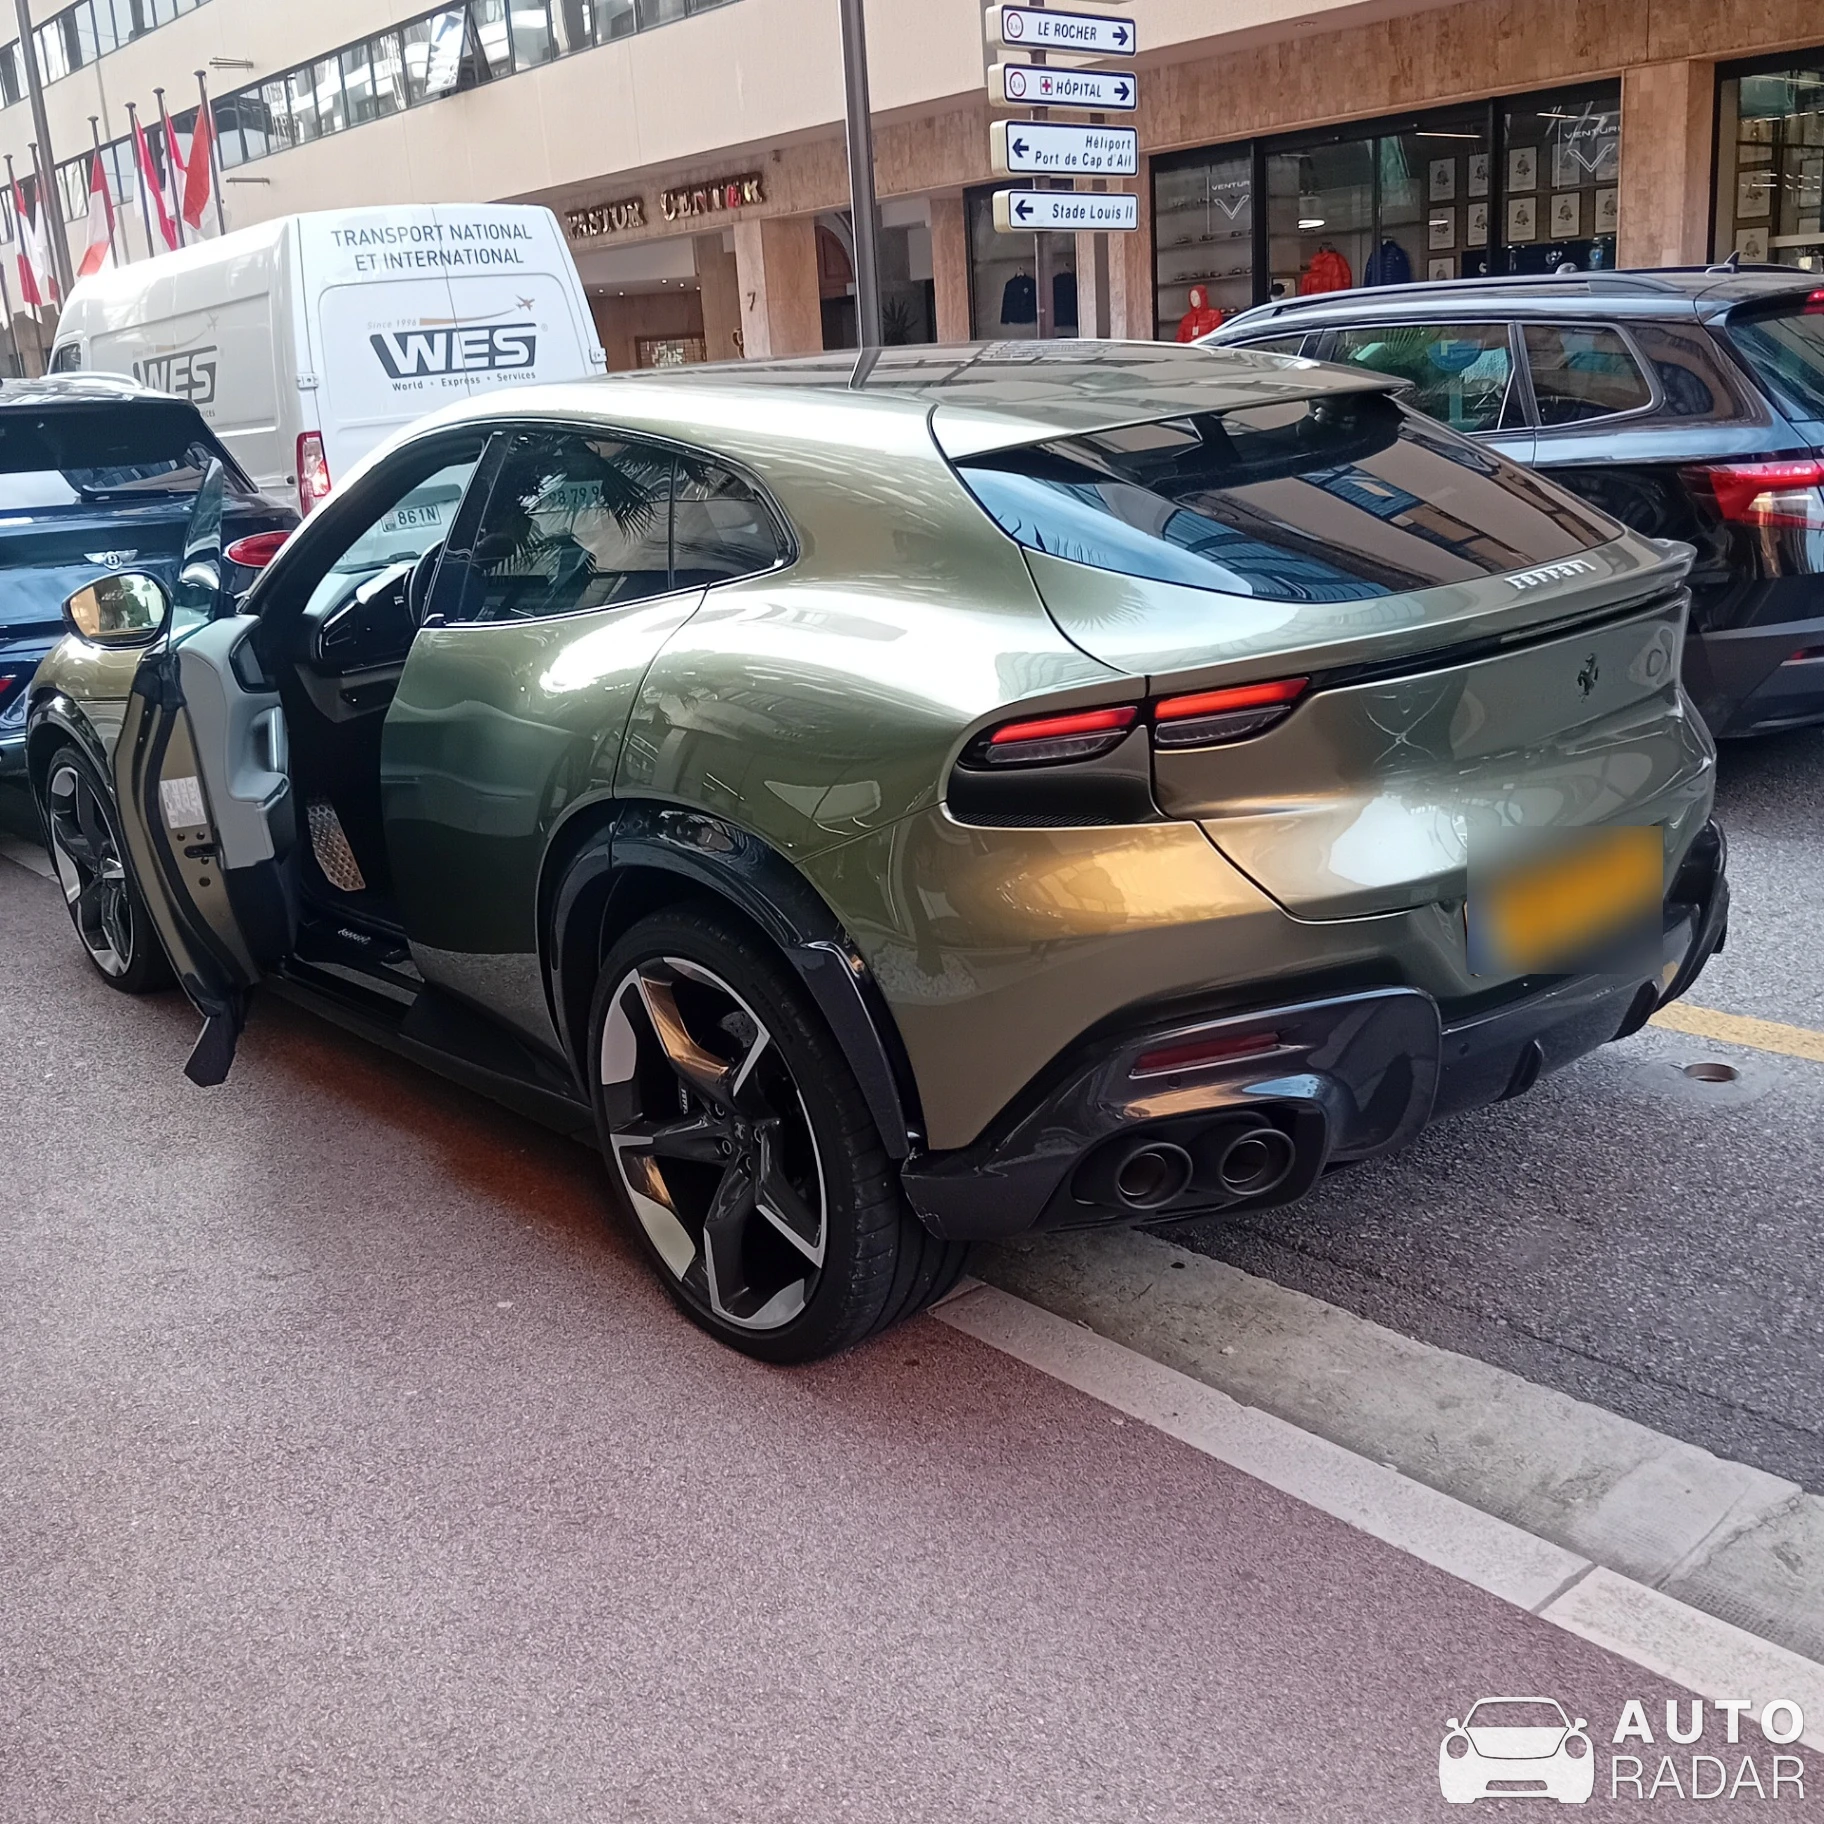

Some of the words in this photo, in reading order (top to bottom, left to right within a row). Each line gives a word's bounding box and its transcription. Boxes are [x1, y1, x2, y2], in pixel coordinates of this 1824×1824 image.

[1038, 21, 1050, 36] LE
[1054, 22, 1097, 41] ROCHER
[1056, 79, 1102, 98] HÔPITAL
[1086, 135, 1131, 152] Héliport
[1035, 151, 1059, 165] Port
[1065, 153, 1077, 166] de
[1082, 152, 1102, 169] Cap
[1211, 180, 1250, 190] VENTUR
[660, 179, 763, 221] CENTER
[1052, 203, 1085, 219] Stade
[1090, 204, 1121, 220] Louis
[1125, 205, 1133, 219] II
[331, 224, 443, 247] TRANSPORT
[450, 223, 532, 241] NATIONAL
[355, 253, 377, 271] ET
[384, 248, 524, 268] INTERNATIONAL
[747, 292, 756, 311] 7
[367, 320, 393, 330] Since
[372, 324, 536, 377] WES
[392, 380, 424, 391] World
[441, 376, 481, 388] Express
[497, 371, 536, 382] Services
